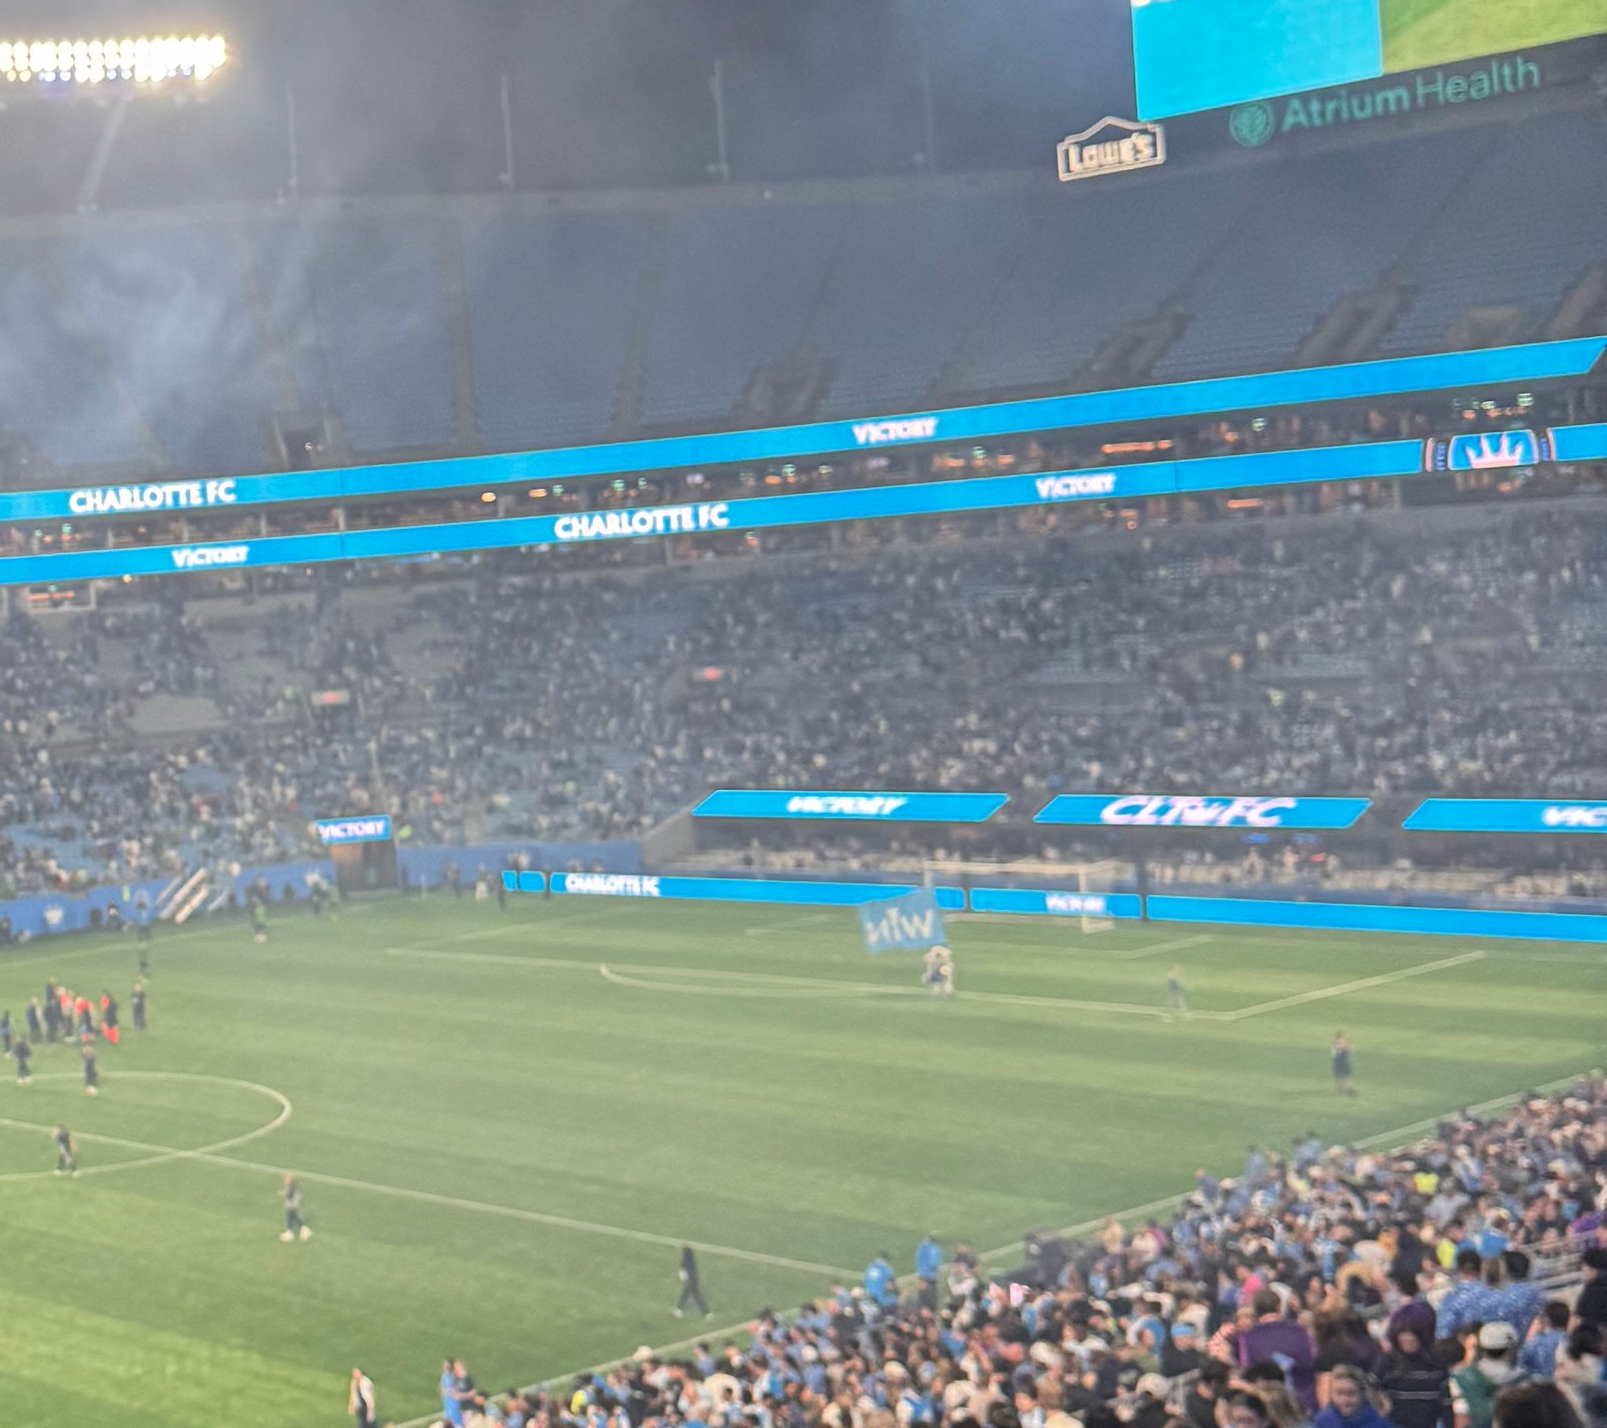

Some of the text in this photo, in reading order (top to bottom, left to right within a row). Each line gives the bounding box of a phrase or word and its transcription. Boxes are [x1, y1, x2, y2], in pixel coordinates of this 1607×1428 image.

[1282, 55, 1541, 133] Atrium Health
[852, 416, 938, 444] VICTORY
[69, 479, 236, 513] CHARLOTTE FC
[1035, 473, 1116, 498] VICTORY
[554, 503, 730, 539] CHARLOTTE FC
[171, 545, 250, 568] VICTORY
[316, 820, 385, 843] VICTORY
